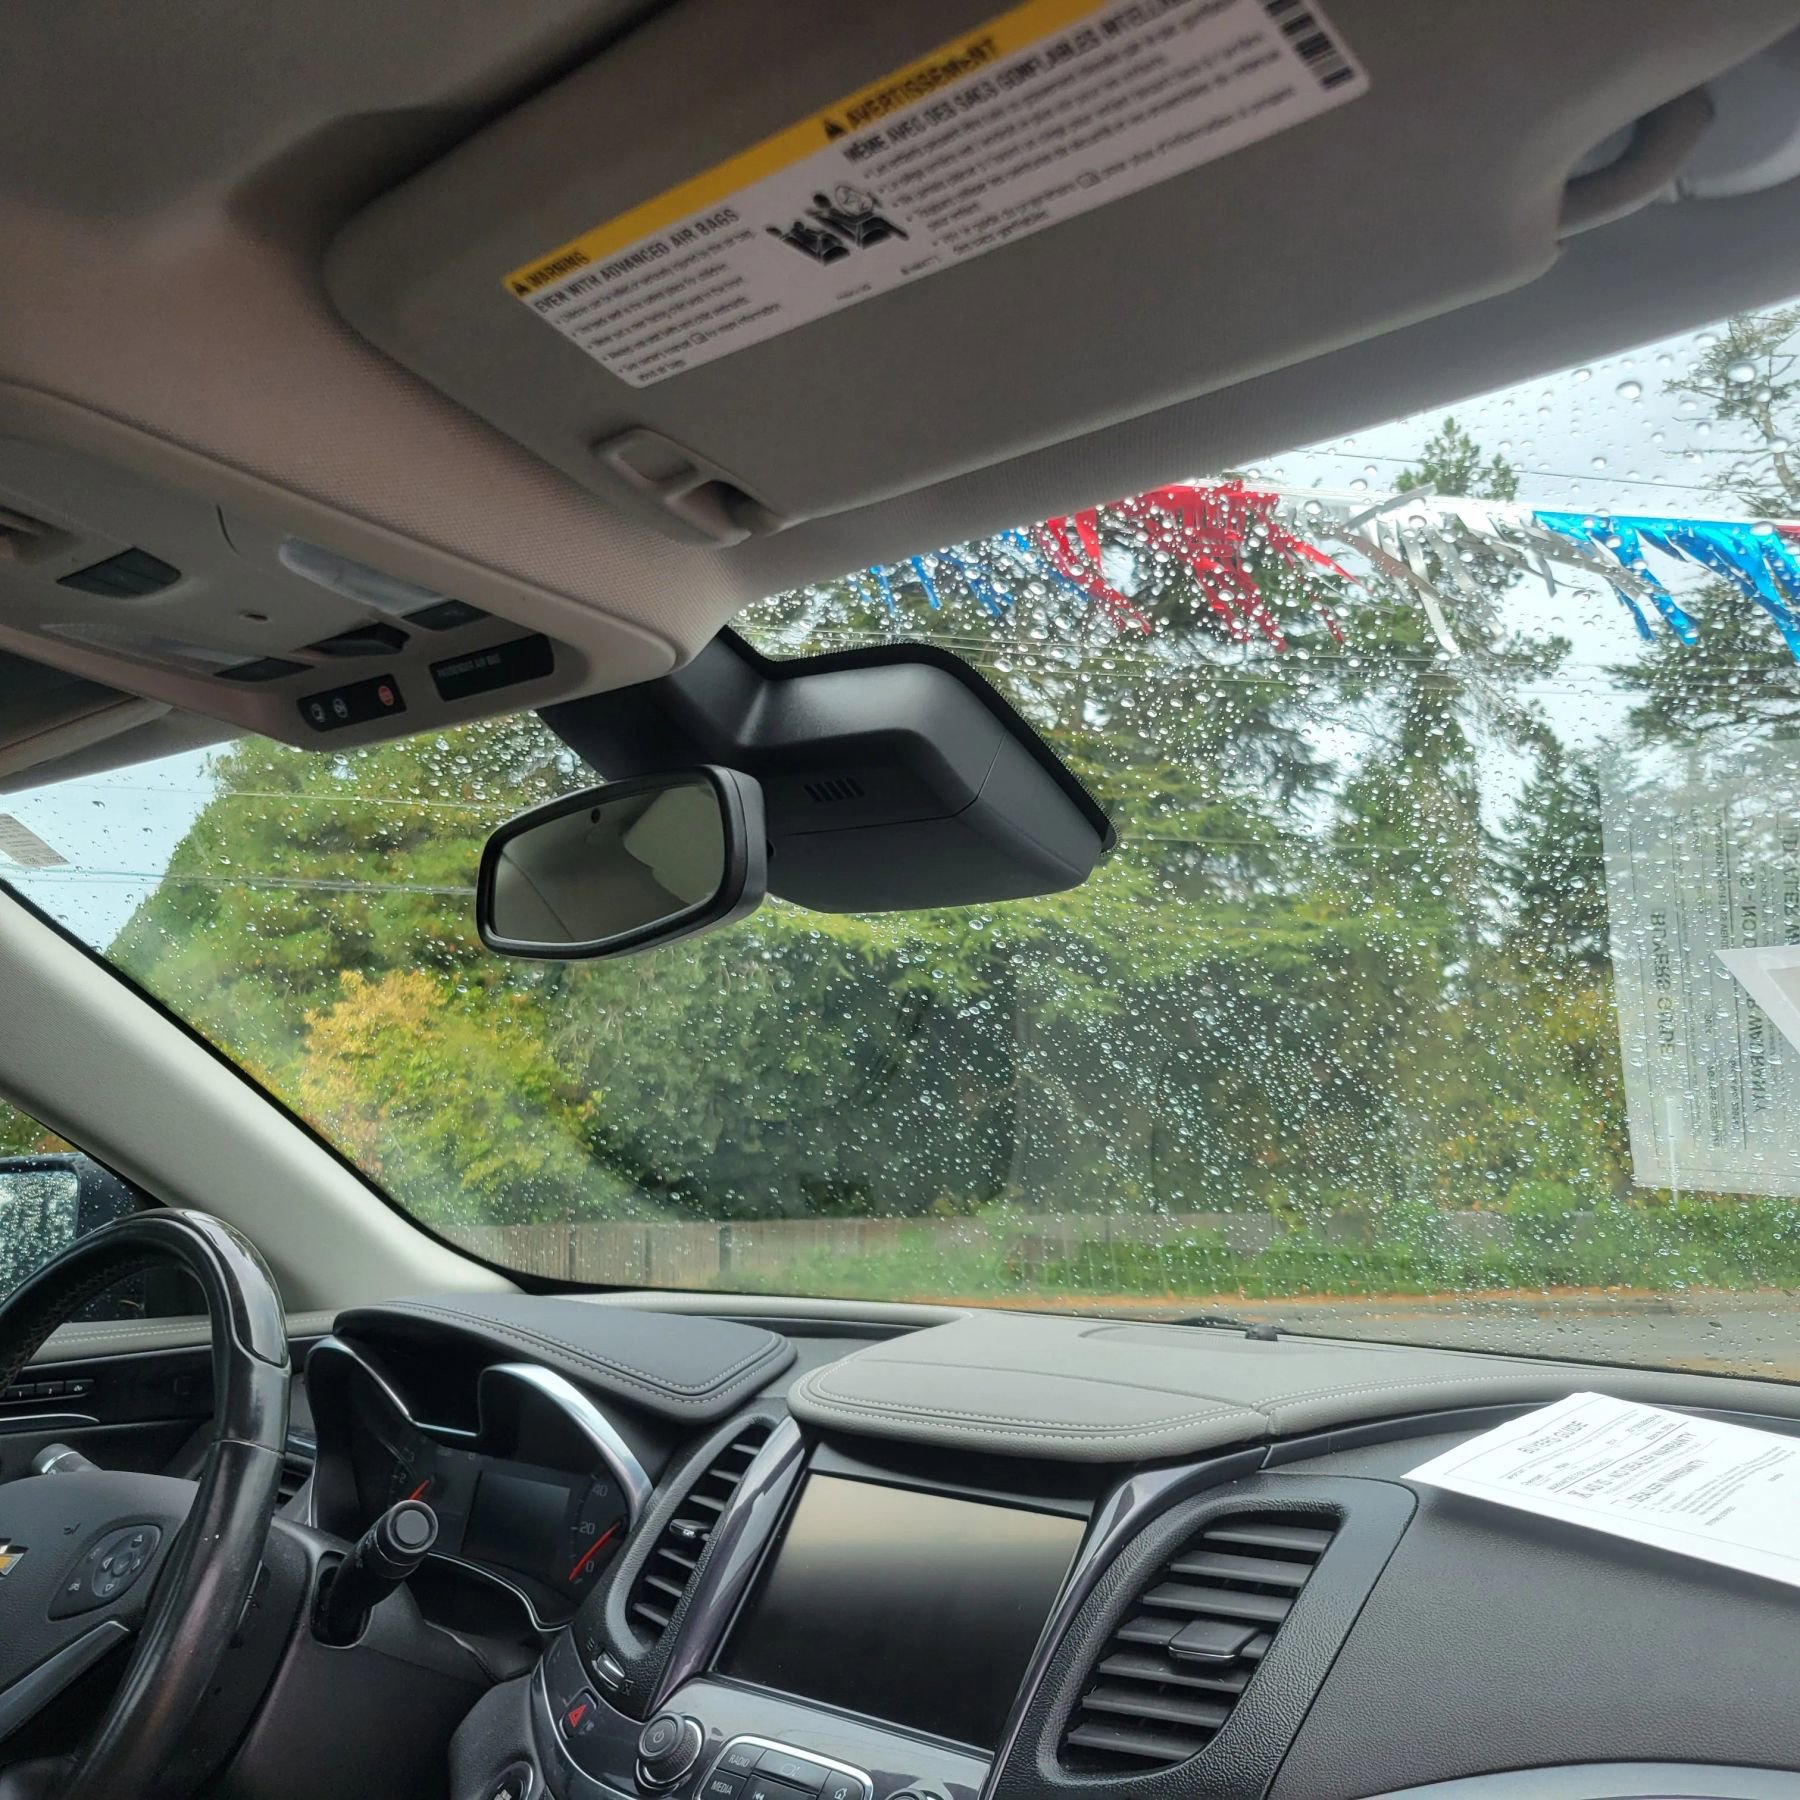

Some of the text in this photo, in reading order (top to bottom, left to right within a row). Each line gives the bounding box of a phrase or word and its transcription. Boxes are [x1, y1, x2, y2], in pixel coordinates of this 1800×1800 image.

[534, 208, 739, 314] EVEN WITH ADVANCED AIR BAGS
[527, 250, 592, 288] WARNING
[1517, 1420, 1589, 1454] BUYERS GUIDE
[592, 1484, 608, 1497] 40
[579, 1520, 595, 1535] 20
[585, 1560, 595, 1573] 0
[728, 1754, 750, 1768] RADIO
[711, 1780, 733, 1795] MEDIA
